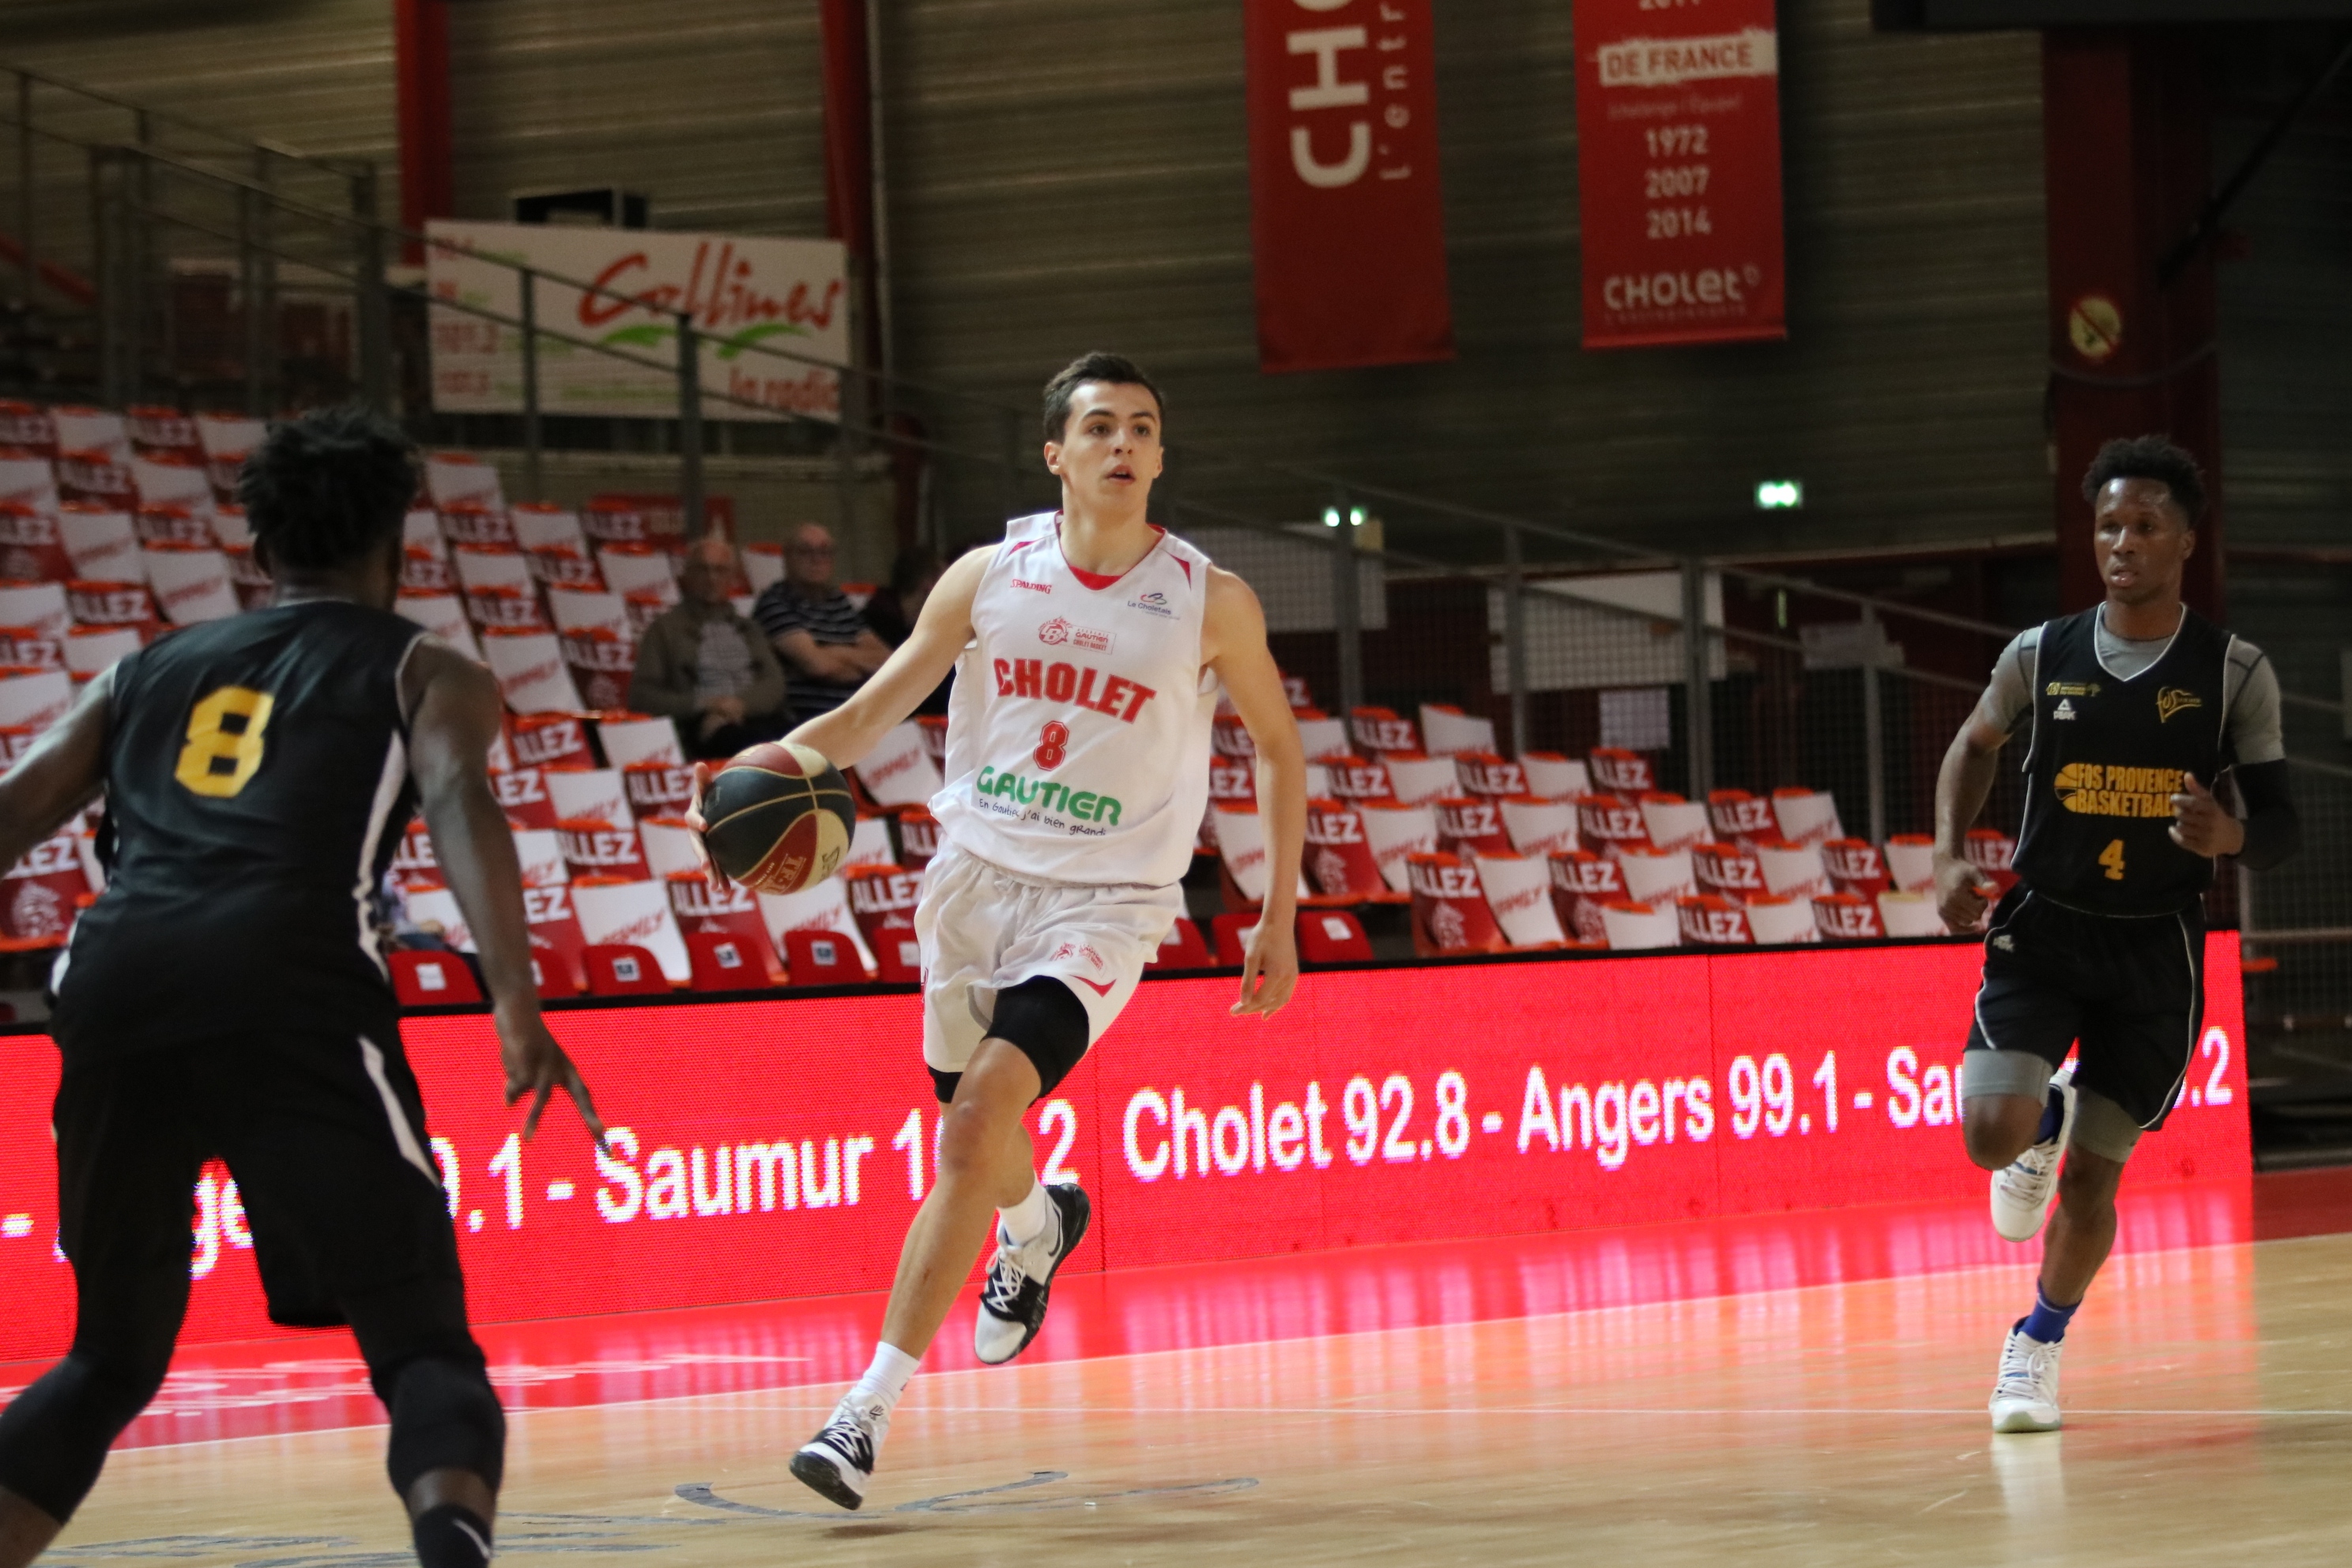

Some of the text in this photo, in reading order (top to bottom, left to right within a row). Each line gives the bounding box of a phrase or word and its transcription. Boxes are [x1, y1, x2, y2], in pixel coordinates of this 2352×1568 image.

[1607, 41, 1755, 79] DE FRANCE
[1285, 0, 1372, 188] CH
[1645, 124, 1709, 158] 1972
[1645, 164, 1710, 198] 2007
[1646, 205, 1712, 239] 2014
[1011, 579, 1052, 594] SPALDING
[1138, 603, 1171, 615] Choletais
[993, 658, 1157, 725] CHOLET
[174, 684, 275, 798] 8
[1033, 720, 1069, 771] 8
[977, 766, 1122, 827] GAUTIER
[2077, 763, 2184, 793] FOS PROVENCE
[979, 798, 989, 809] En
[1020, 808, 1040, 821] j'ai
[1044, 816, 1065, 829] bien
[2098, 839, 2125, 880] 4
[1121, 1080, 1333, 1183] Cholet
[1343, 1069, 1471, 1167] 92.8
[1517, 1061, 1715, 1172] Angers
[1728, 1050, 1838, 1140] 99.1
[594, 1125, 874, 1223] Saumur
